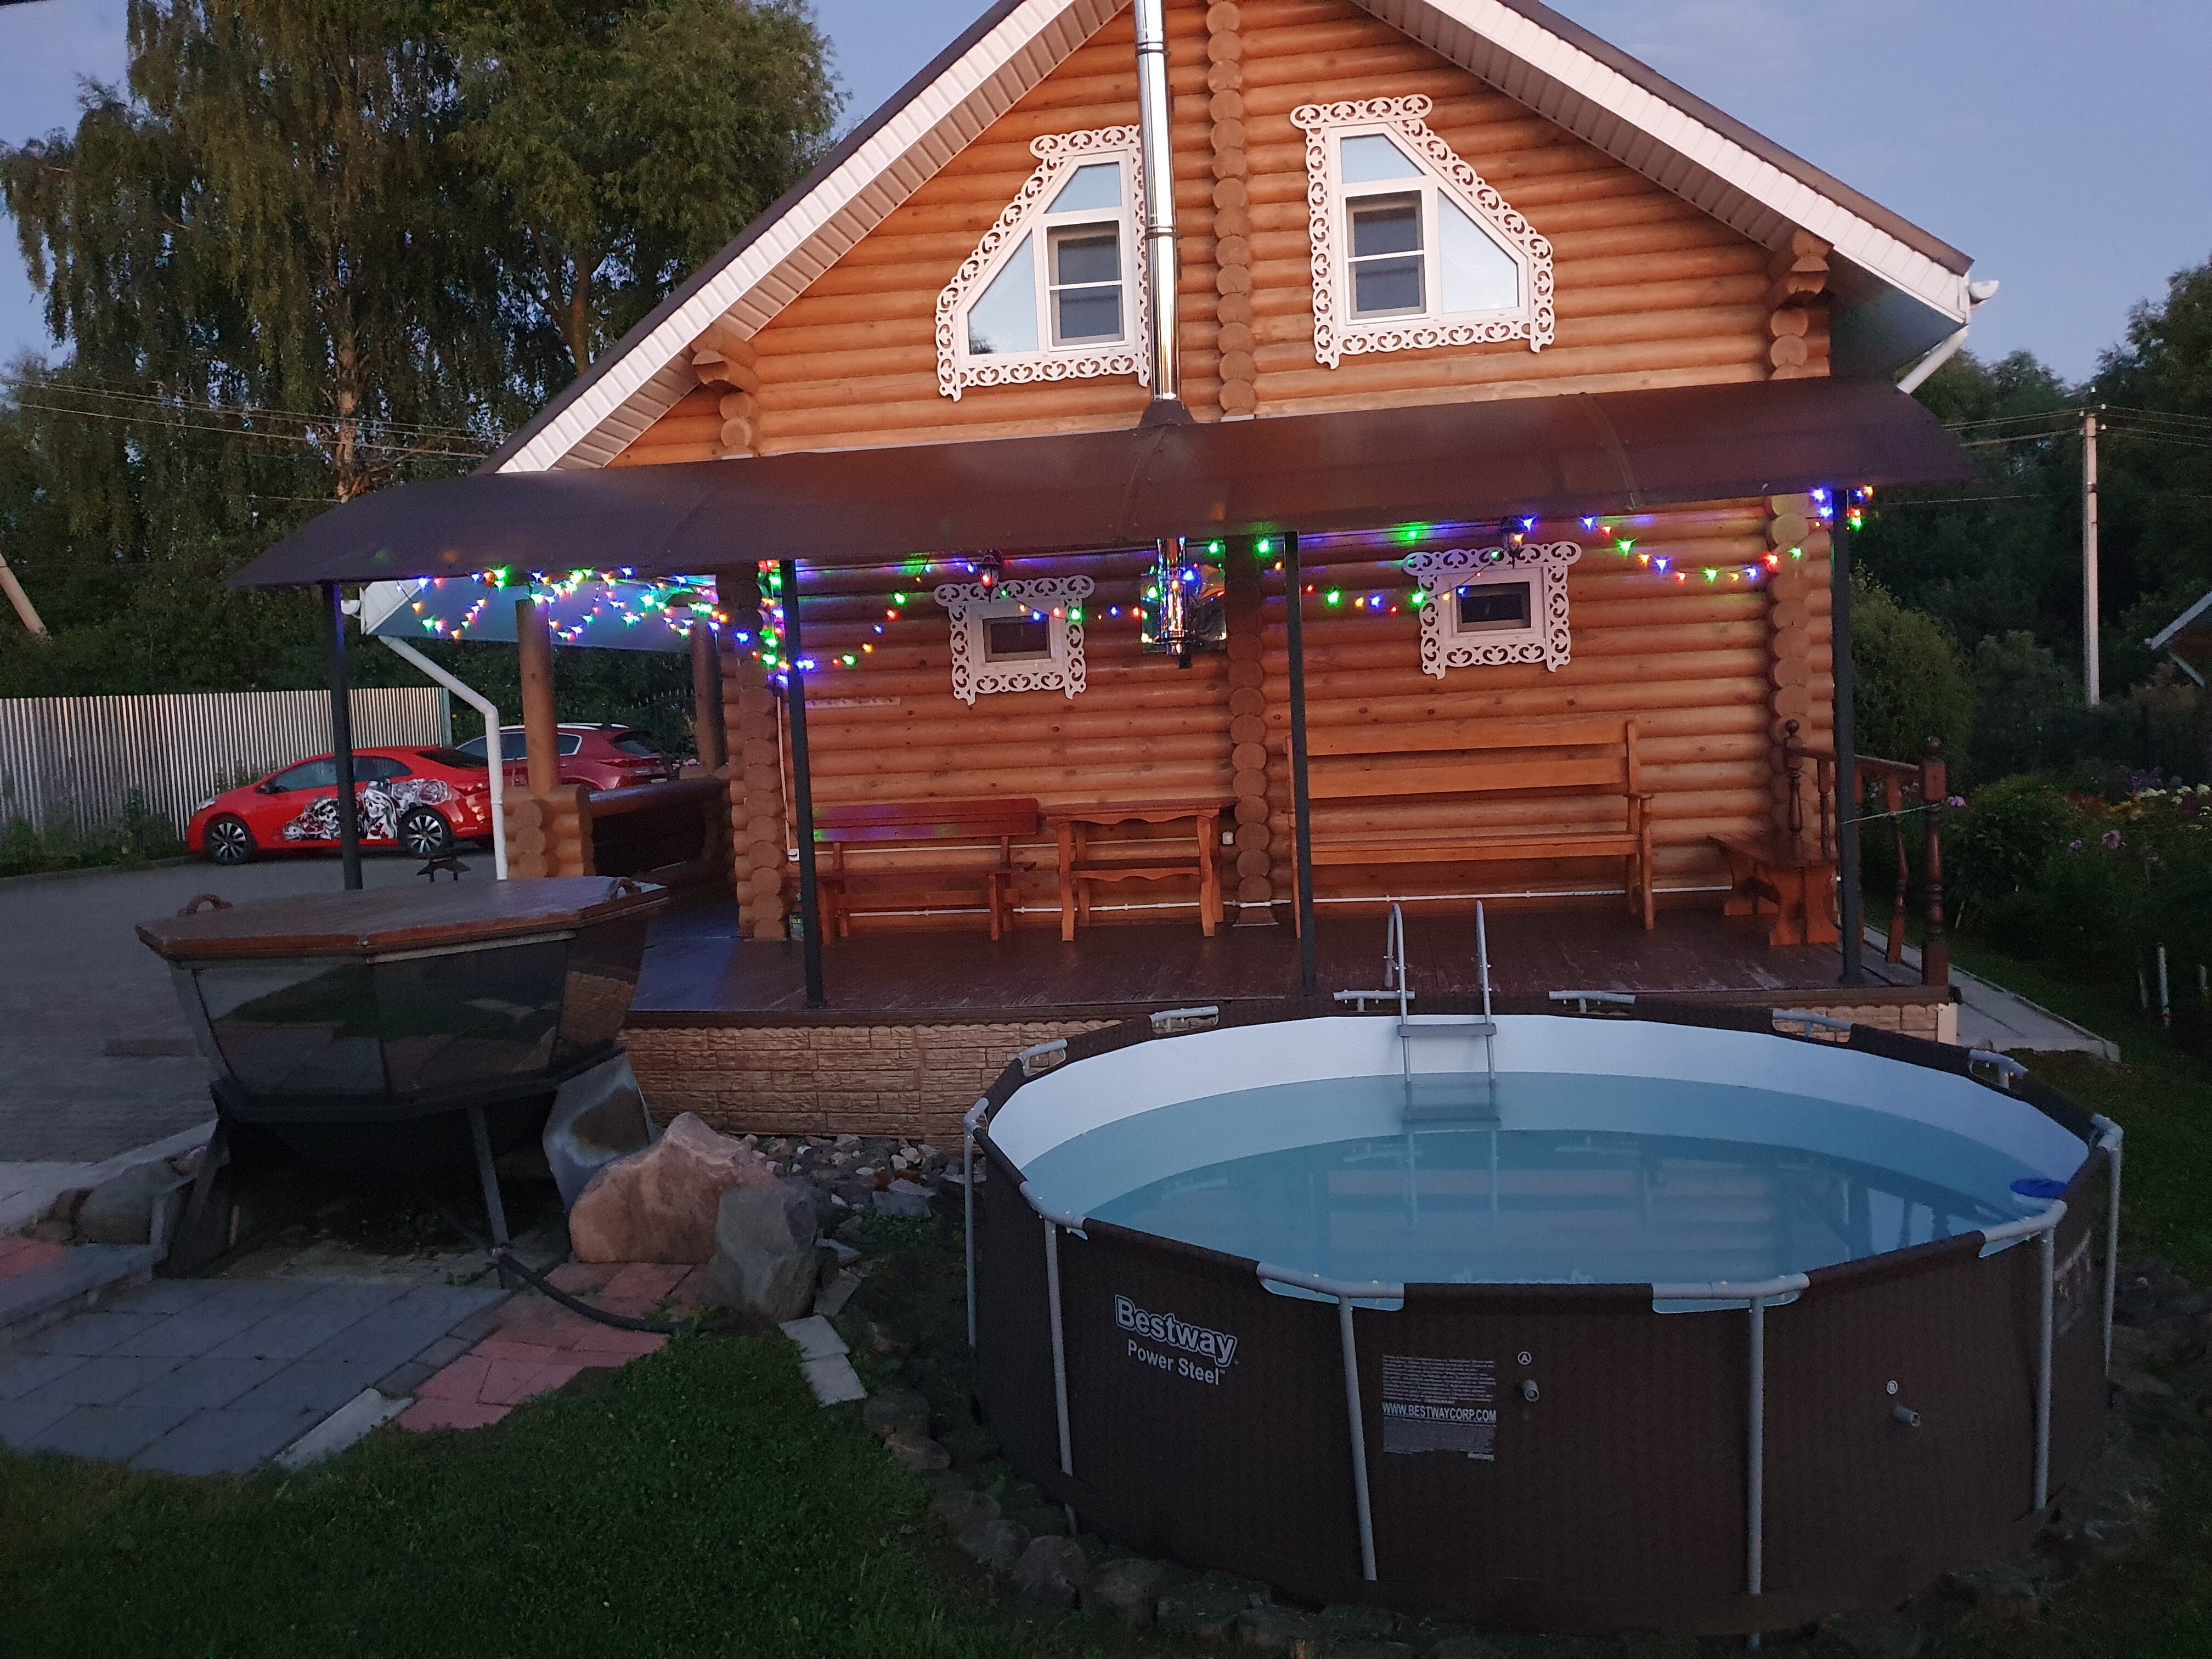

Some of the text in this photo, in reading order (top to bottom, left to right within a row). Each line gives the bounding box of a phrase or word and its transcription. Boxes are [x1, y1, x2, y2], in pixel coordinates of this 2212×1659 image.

[1115, 1294, 1238, 1367] Bestway
[1128, 1339, 1174, 1371] Power
[1383, 1402, 1497, 1422] WWW.BESTWAYCORP.COM
